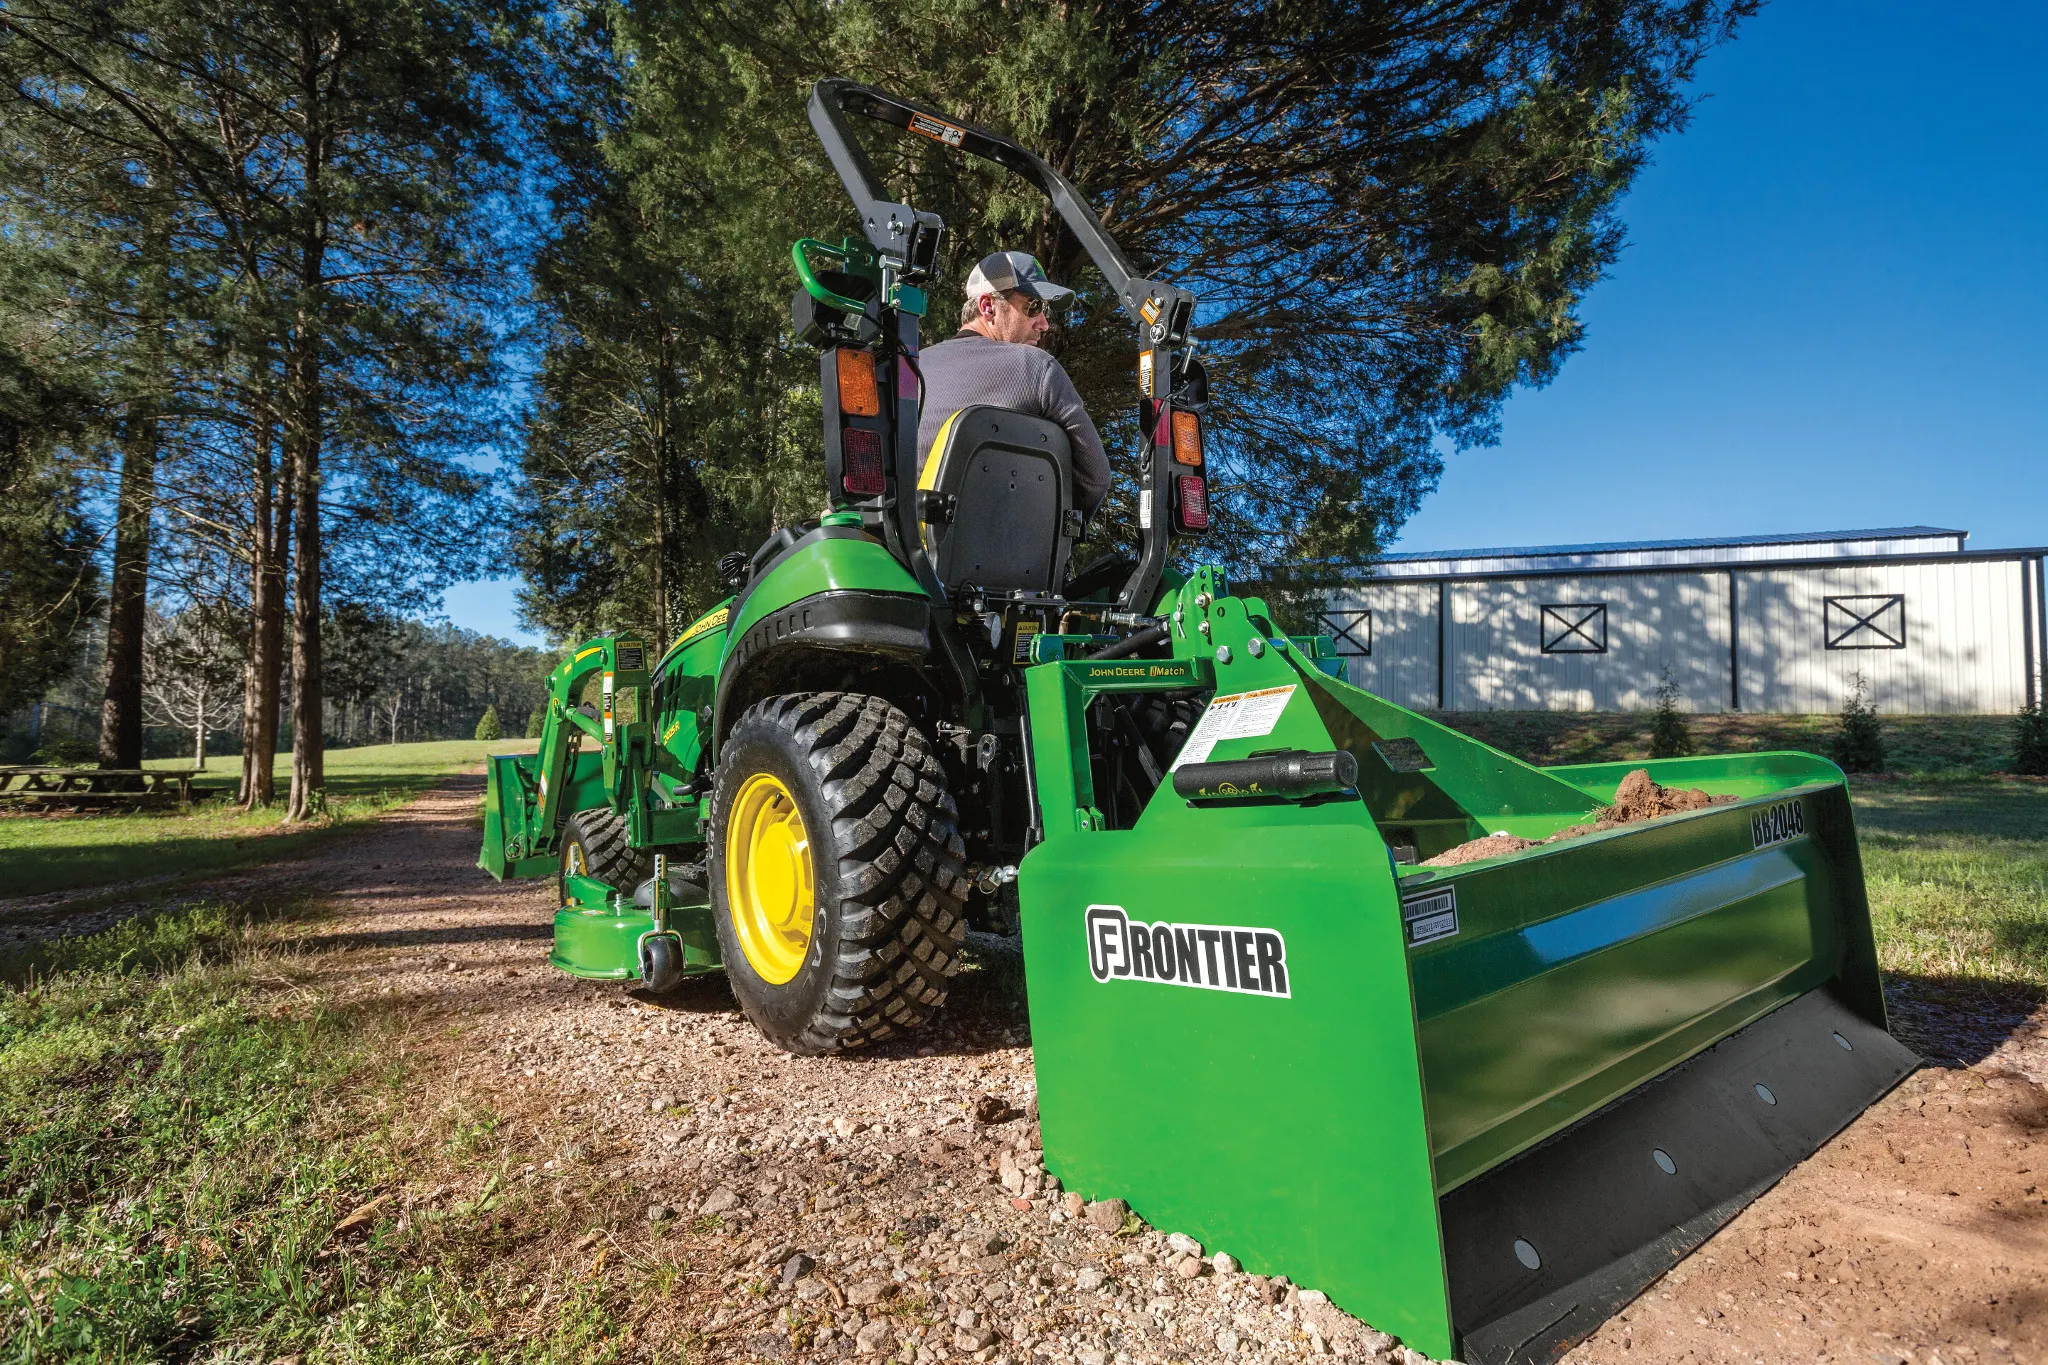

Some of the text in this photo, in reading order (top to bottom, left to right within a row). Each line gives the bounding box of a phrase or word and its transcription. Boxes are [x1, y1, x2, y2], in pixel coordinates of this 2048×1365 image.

[692, 612, 728, 636] JOHN DEE
[1089, 667, 1114, 677] JOHN
[1115, 667, 1146, 677] DEERE
[1751, 800, 1804, 848] BB2048
[1087, 908, 1288, 994] FRONTIER
